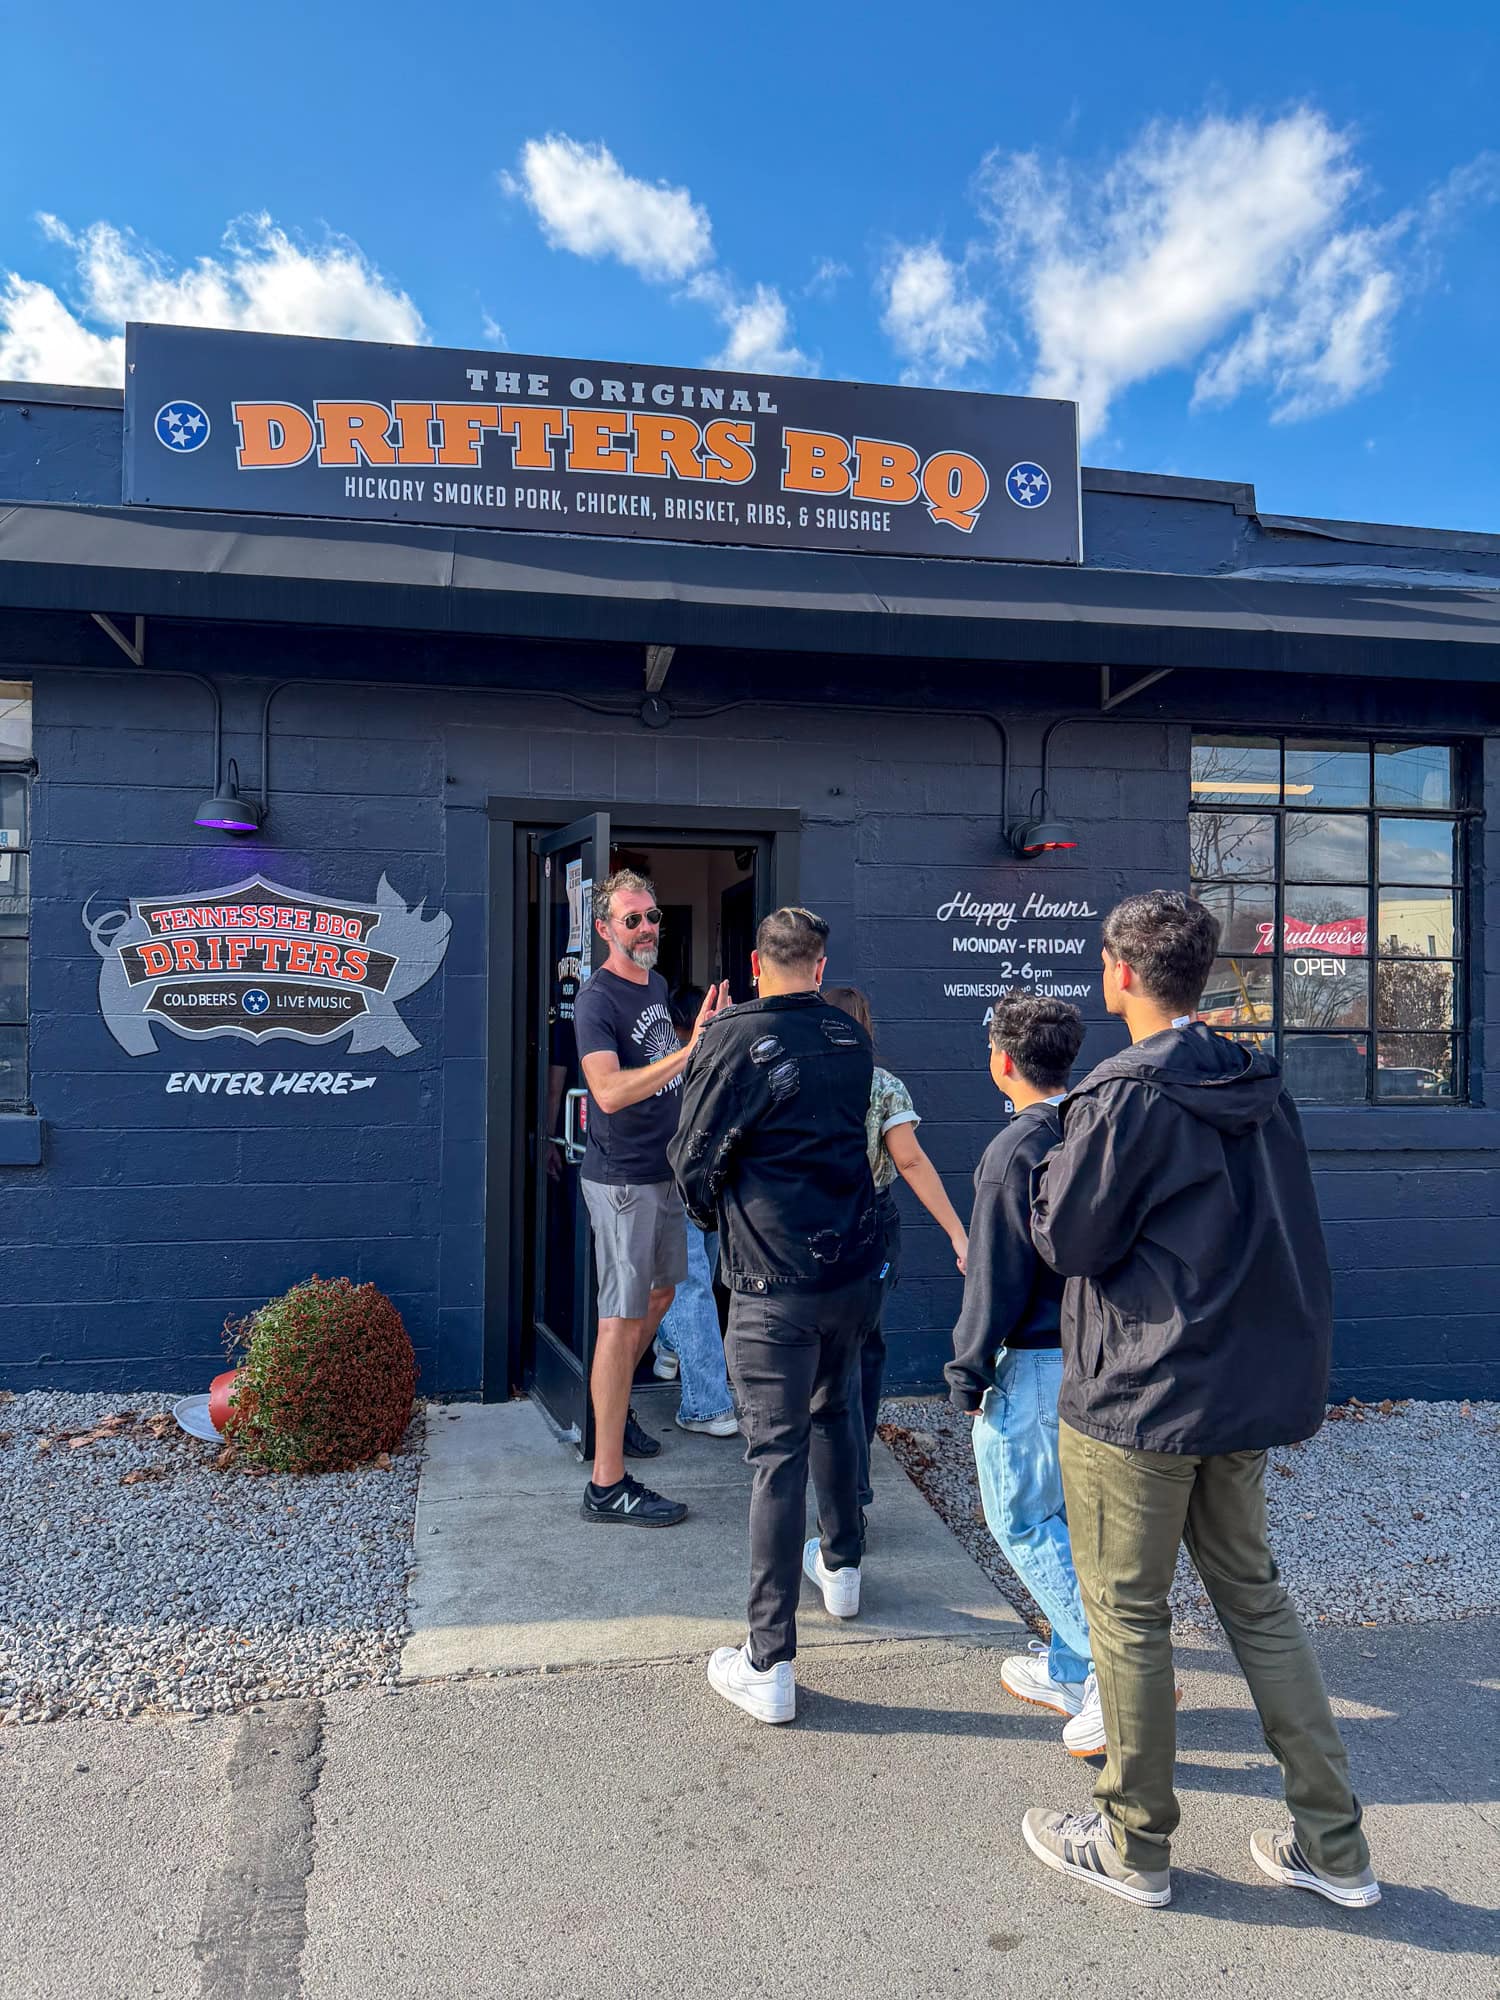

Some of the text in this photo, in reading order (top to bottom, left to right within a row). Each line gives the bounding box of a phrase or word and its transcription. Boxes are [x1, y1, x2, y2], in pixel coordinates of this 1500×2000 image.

[466, 368, 778, 415] THE ORIGINAL
[231, 400, 990, 534] DRIFTERS BBQ
[345, 476, 891, 532] HICKORY SMOKED PORK, CHICKEN, BRISKET, RIBS, & SAUSAGE
[151, 904, 364, 941] TENNESSEE BBQ
[936, 891, 1098, 930] Happy Hours
[136, 935, 372, 983] DRIFTERS
[1000, 962, 1053, 982] 2-6pm
[1293, 958, 1346, 976] OPEN
[276, 994, 351, 1010] LIVE MUSIC
[944, 984, 1014, 997] WEDNESDAY
[1035, 984, 1091, 997] SUNDAY
[165, 1071, 353, 1096] ENTER HERE
